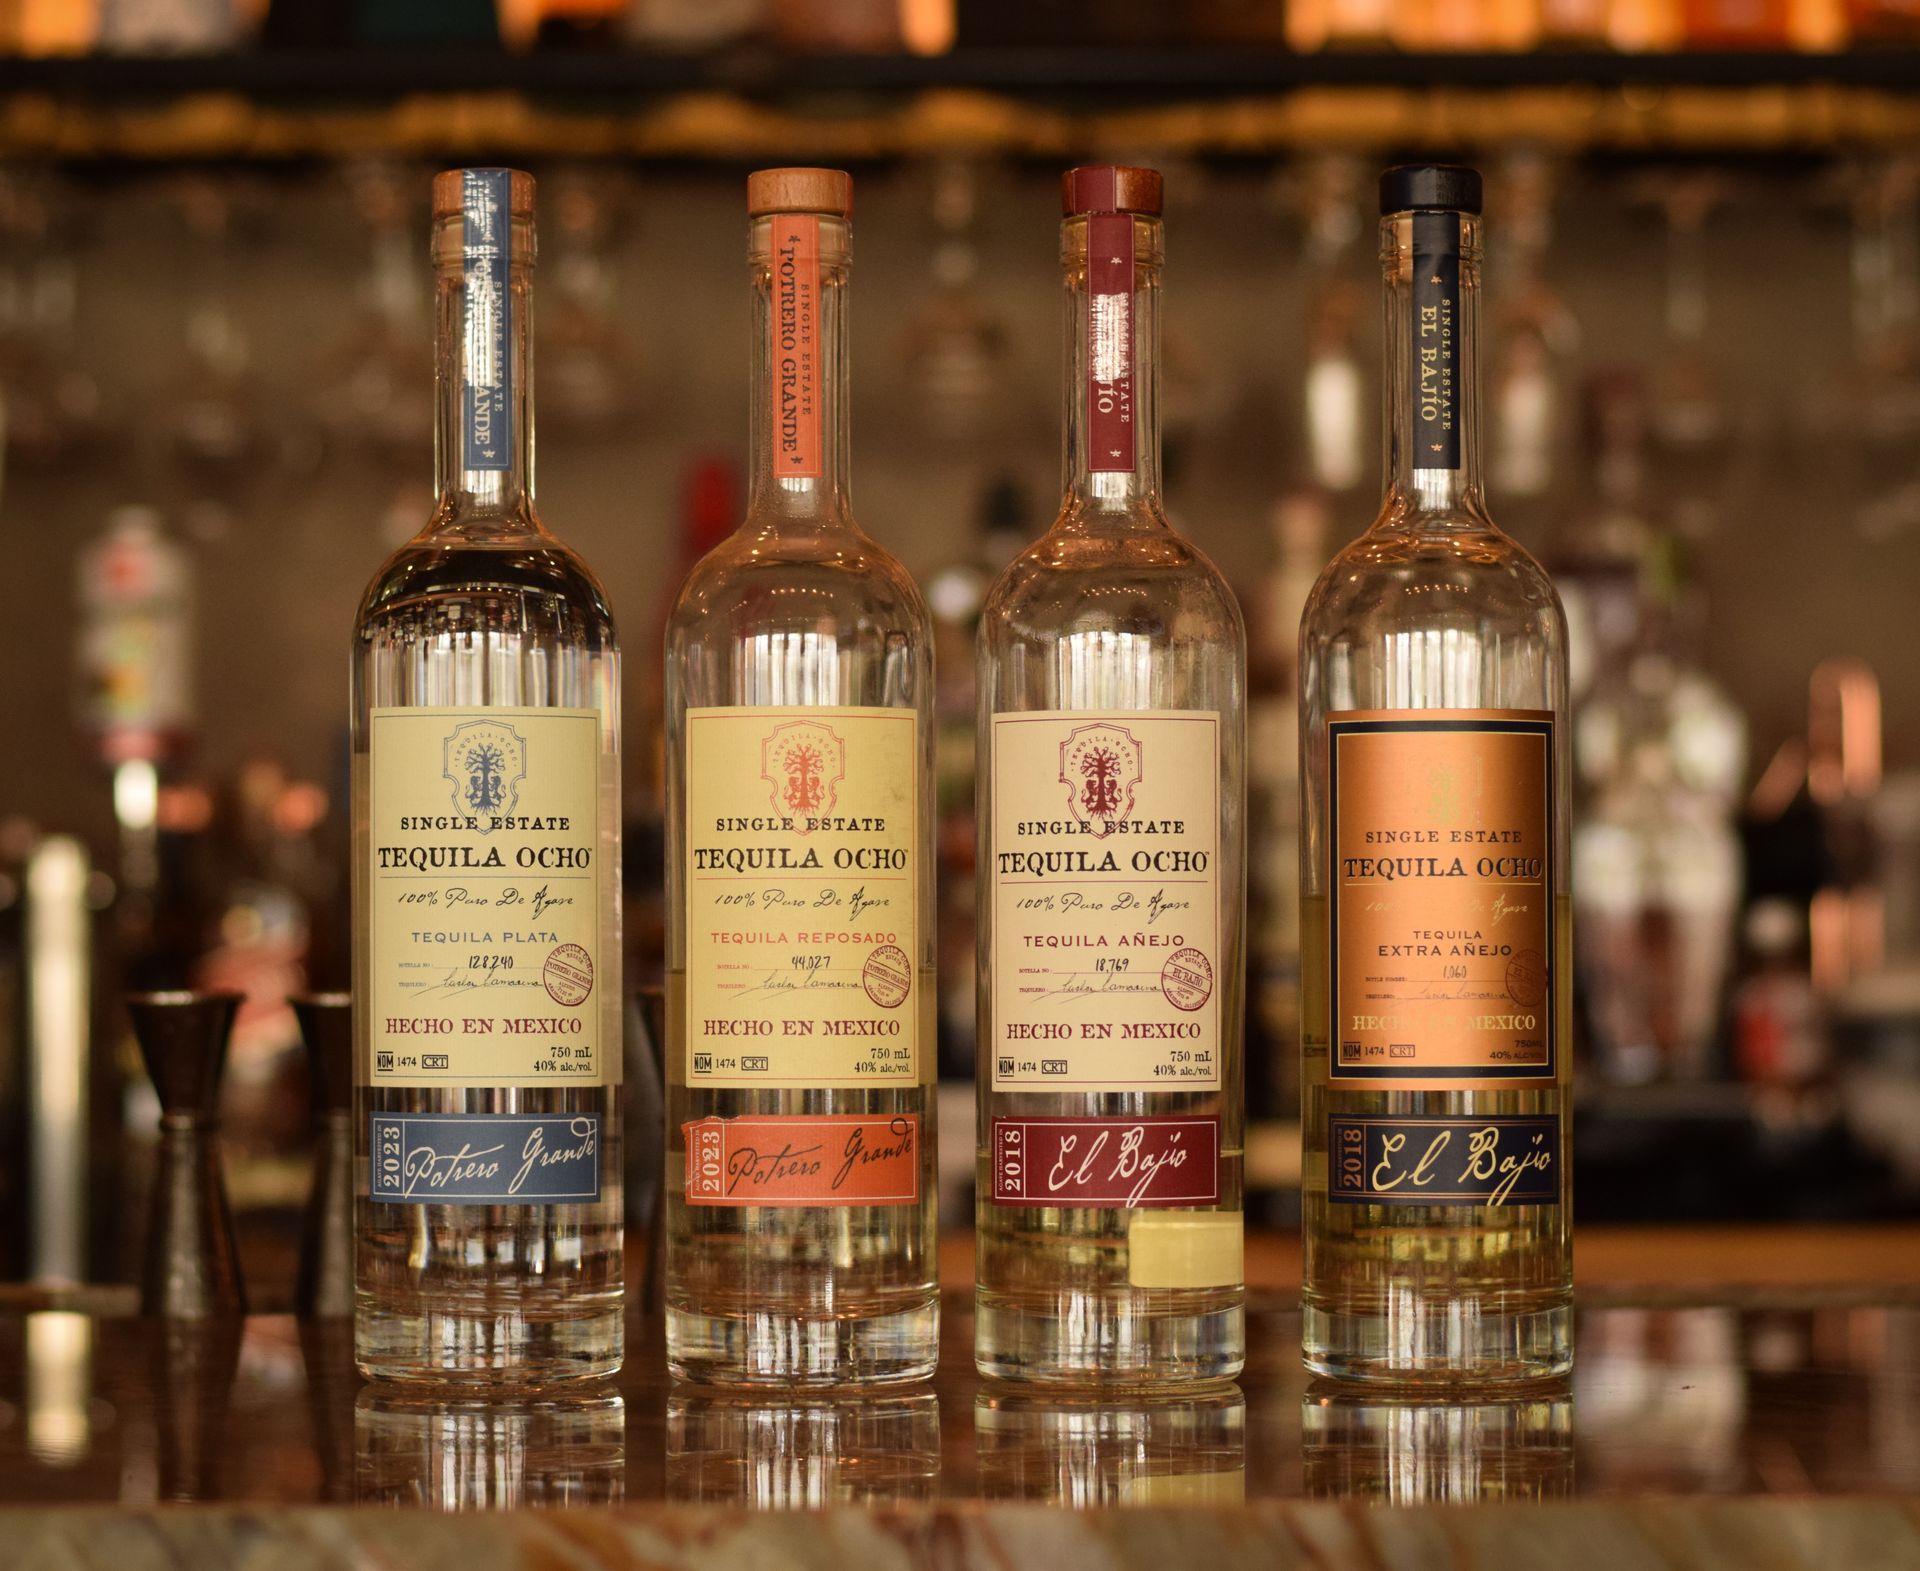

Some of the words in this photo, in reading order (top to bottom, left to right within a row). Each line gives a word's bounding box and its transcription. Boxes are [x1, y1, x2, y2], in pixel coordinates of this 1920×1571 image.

[779, 247, 796, 351] POTRERO
[801, 284, 810, 344] SINGLE
[1421, 306, 1437, 338] EL
[1442, 299, 1450, 359] SINGLE
[802, 353, 811, 415] ESTATE
[1421, 347, 1441, 422] BAJÍO
[780, 358, 797, 452] GRANDE
[1442, 368, 1451, 430] ESTATE
[401, 817, 478, 831] SINGLE
[490, 817, 569, 831] ESTATE
[717, 818, 793, 831] SINGLE
[807, 818, 885, 831] ESTATE
[1018, 821, 1091, 835] SINGLE
[1104, 821, 1184, 834] ESTATE
[1366, 831, 1439, 844] SINGLE
[1450, 831, 1522, 843] ESTATE
[378, 847, 505, 872] TEQUILA
[516, 847, 590, 868] OCHO
[695, 848, 823, 872] TEQUILA
[834, 849, 906, 869] OCHO
[999, 851, 1121, 876] TEQUILA
[1132, 851, 1207, 872] OCHO
[1344, 858, 1467, 880] TEQUILA
[1477, 858, 1542, 878] OCHO
[398, 890, 437, 904] 100%
[445, 888, 488, 908] Puro
[496, 888, 524, 906] De
[532, 885, 573, 920] Agave
[715, 892, 754, 906] 100%
[763, 889, 805, 909] Puro
[814, 889, 842, 907] De
[849, 886, 889, 921] Agave
[1016, 896, 1054, 910] 100%
[1061, 893, 1103, 913] Puro
[1111, 892, 1140, 911] De
[1147, 889, 1189, 924] Agave
[412, 933, 492, 944] TEQUILA
[503, 933, 558, 943] PLATA
[712, 933, 788, 944] TEQUILA
[798, 933, 896, 944] REPOSADO
[1024, 935, 1108, 948] TEQUILA
[1118, 932, 1185, 947] AÑEJO
[1413, 931, 1482, 940] TEQUILA
[1378, 946, 1442, 956] EXTRA
[1450, 943, 1512, 956] AÑEJO
[385, 1018, 453, 1034] HECHO
[462, 1018, 494, 1034] EN
[502, 1018, 581, 1034] MEXICO
[704, 1020, 773, 1035] HECHO
[783, 1021, 814, 1035] EN
[823, 1020, 900, 1035] MEXICO
[1007, 1024, 1072, 1039] HECHO
[1081, 1024, 1112, 1039] EN
[1121, 1023, 1201, 1039] MEXICO
[1466, 1015, 1535, 1030] MEXICO
[377, 1052, 393, 1070] NOM
[397, 1057, 416, 1067] 1474
[423, 1056, 447, 1068] CRT
[550, 1047, 571, 1058] 750
[575, 1047, 592, 1058] mL
[870, 1048, 891, 1060] 750
[895, 1048, 910, 1059] mL
[1170, 1051, 1190, 1062] 750
[1195, 1051, 1211, 1062] mL
[1365, 1047, 1384, 1056] 1474
[1390, 1046, 1414, 1057] CRT
[1489, 1051, 1512, 1061] 40%
[534, 1060, 556, 1071] 40%
[694, 1053, 711, 1073] NOM
[716, 1059, 735, 1068] 1474
[743, 1058, 766, 1069] CRT
[854, 1062, 876, 1073] 40%
[999, 1058, 1014, 1077] NOM
[1018, 1062, 1036, 1072] 1474
[1043, 1062, 1066, 1073] CRT
[1154, 1065, 1176, 1076] 40%
[383, 1127, 400, 1187] 2023
[405, 1144, 504, 1198] Potrero
[508, 1117, 596, 1194] Grande
[702, 1132, 719, 1191] 2023
[728, 1144, 823, 1195] Potrero
[832, 1117, 914, 1190] Grande
[1005, 1131, 1020, 1191] 2018
[1049, 1130, 1109, 1191] El
[1344, 1129, 1362, 1188] 2018
[1372, 1130, 1451, 1191] El
